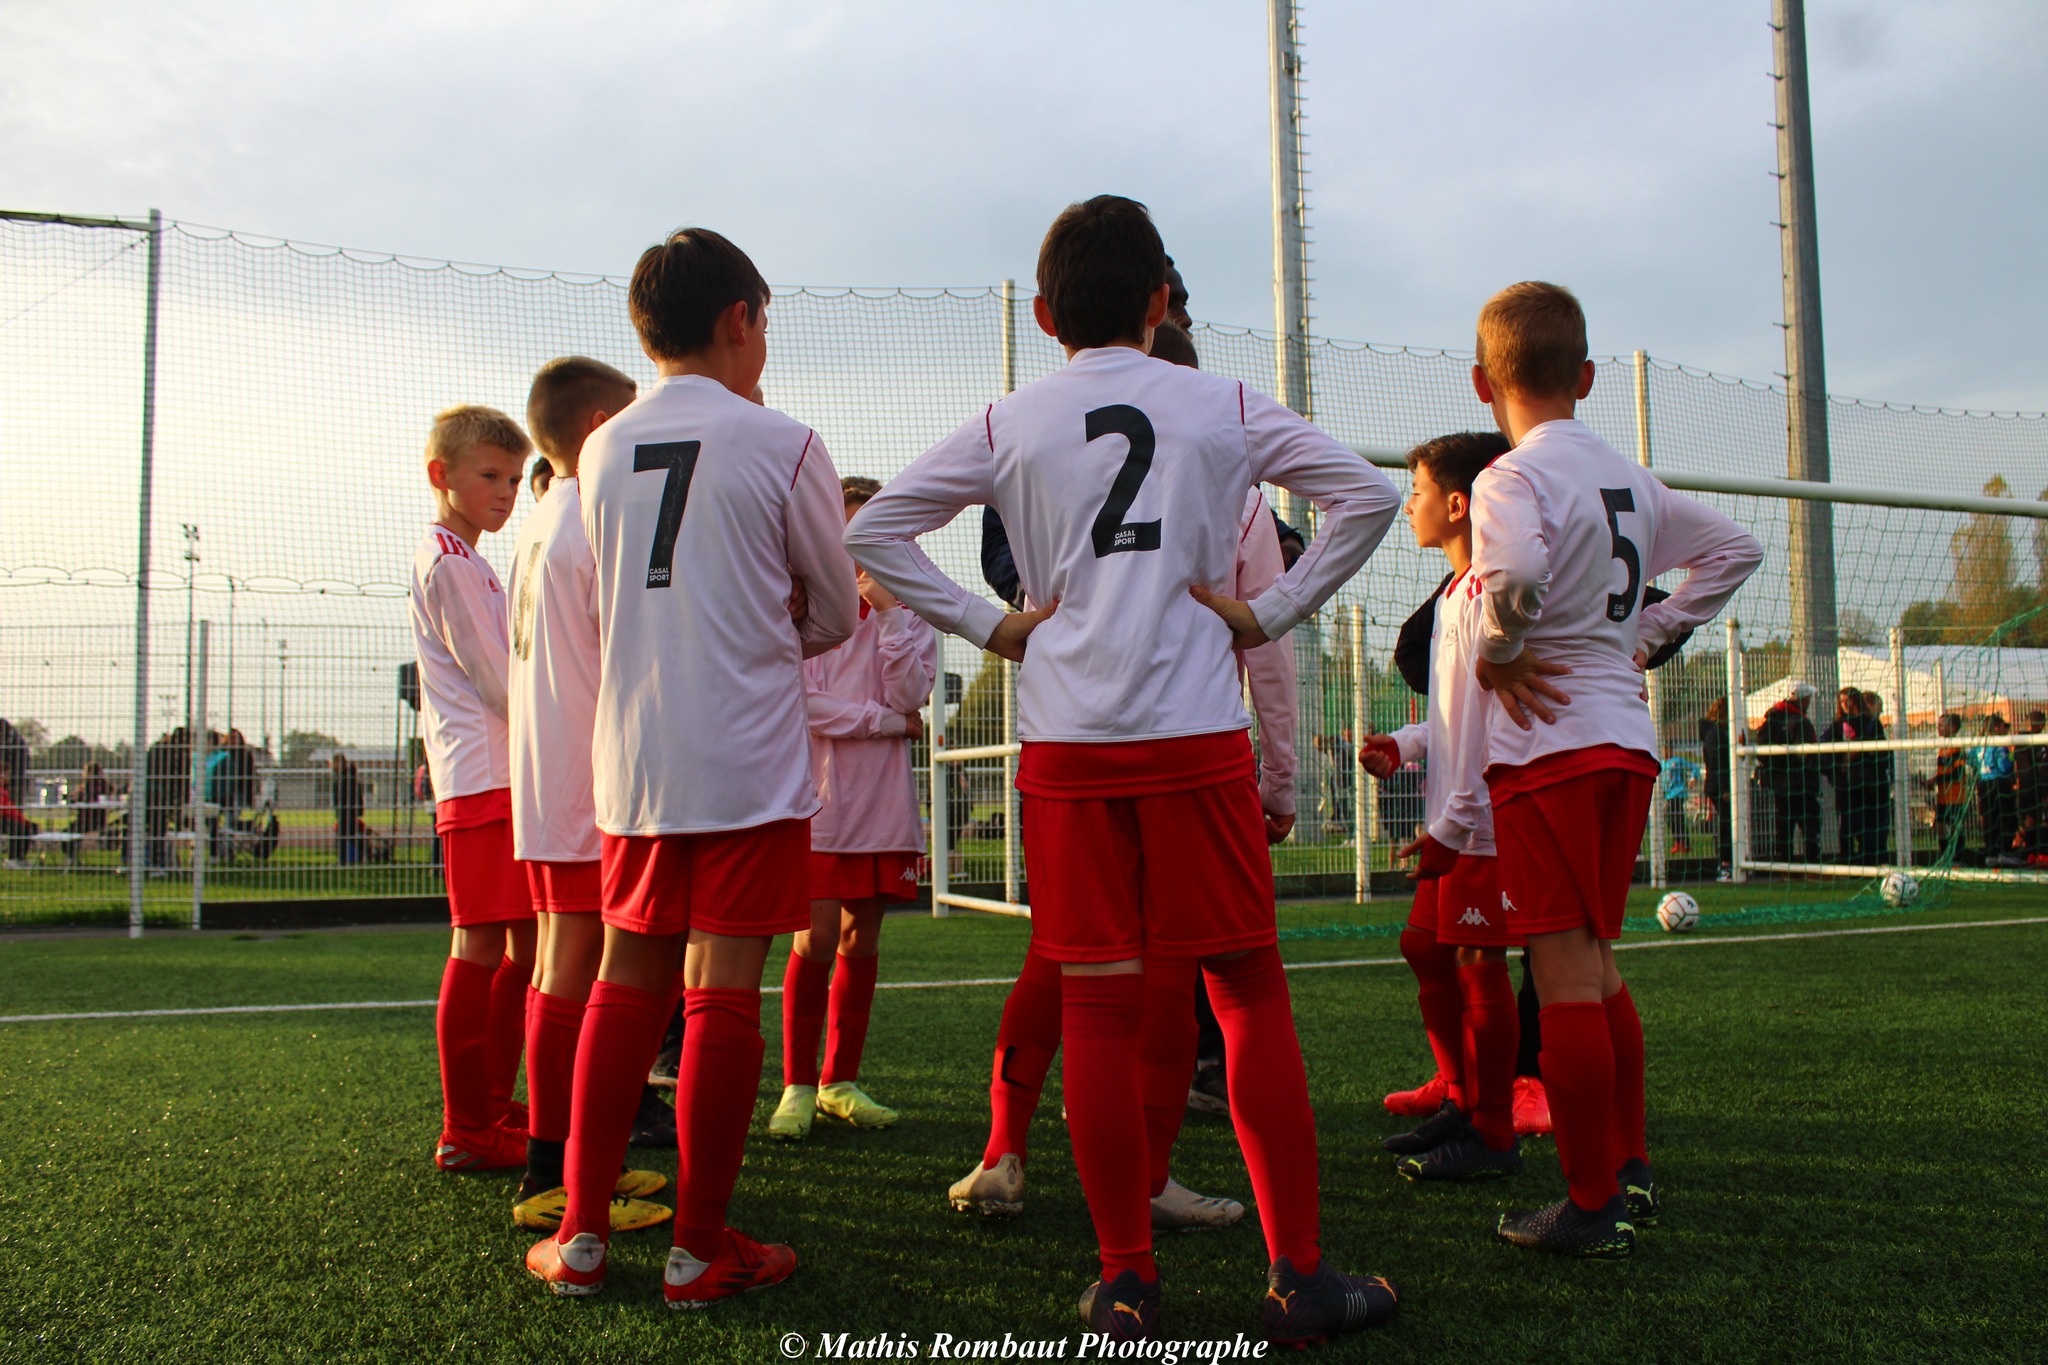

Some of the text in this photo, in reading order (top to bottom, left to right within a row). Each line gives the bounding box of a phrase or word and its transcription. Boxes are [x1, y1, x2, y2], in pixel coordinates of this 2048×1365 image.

[1085, 404, 1163, 559] 2
[633, 440, 702, 589] 7
[1114, 529, 1136, 539] CASAL
[1113, 537, 1136, 547] SPORT
[1599, 487, 1641, 624] 5
[649, 567, 670, 575] CASAL
[649, 574, 670, 583] SPORT
